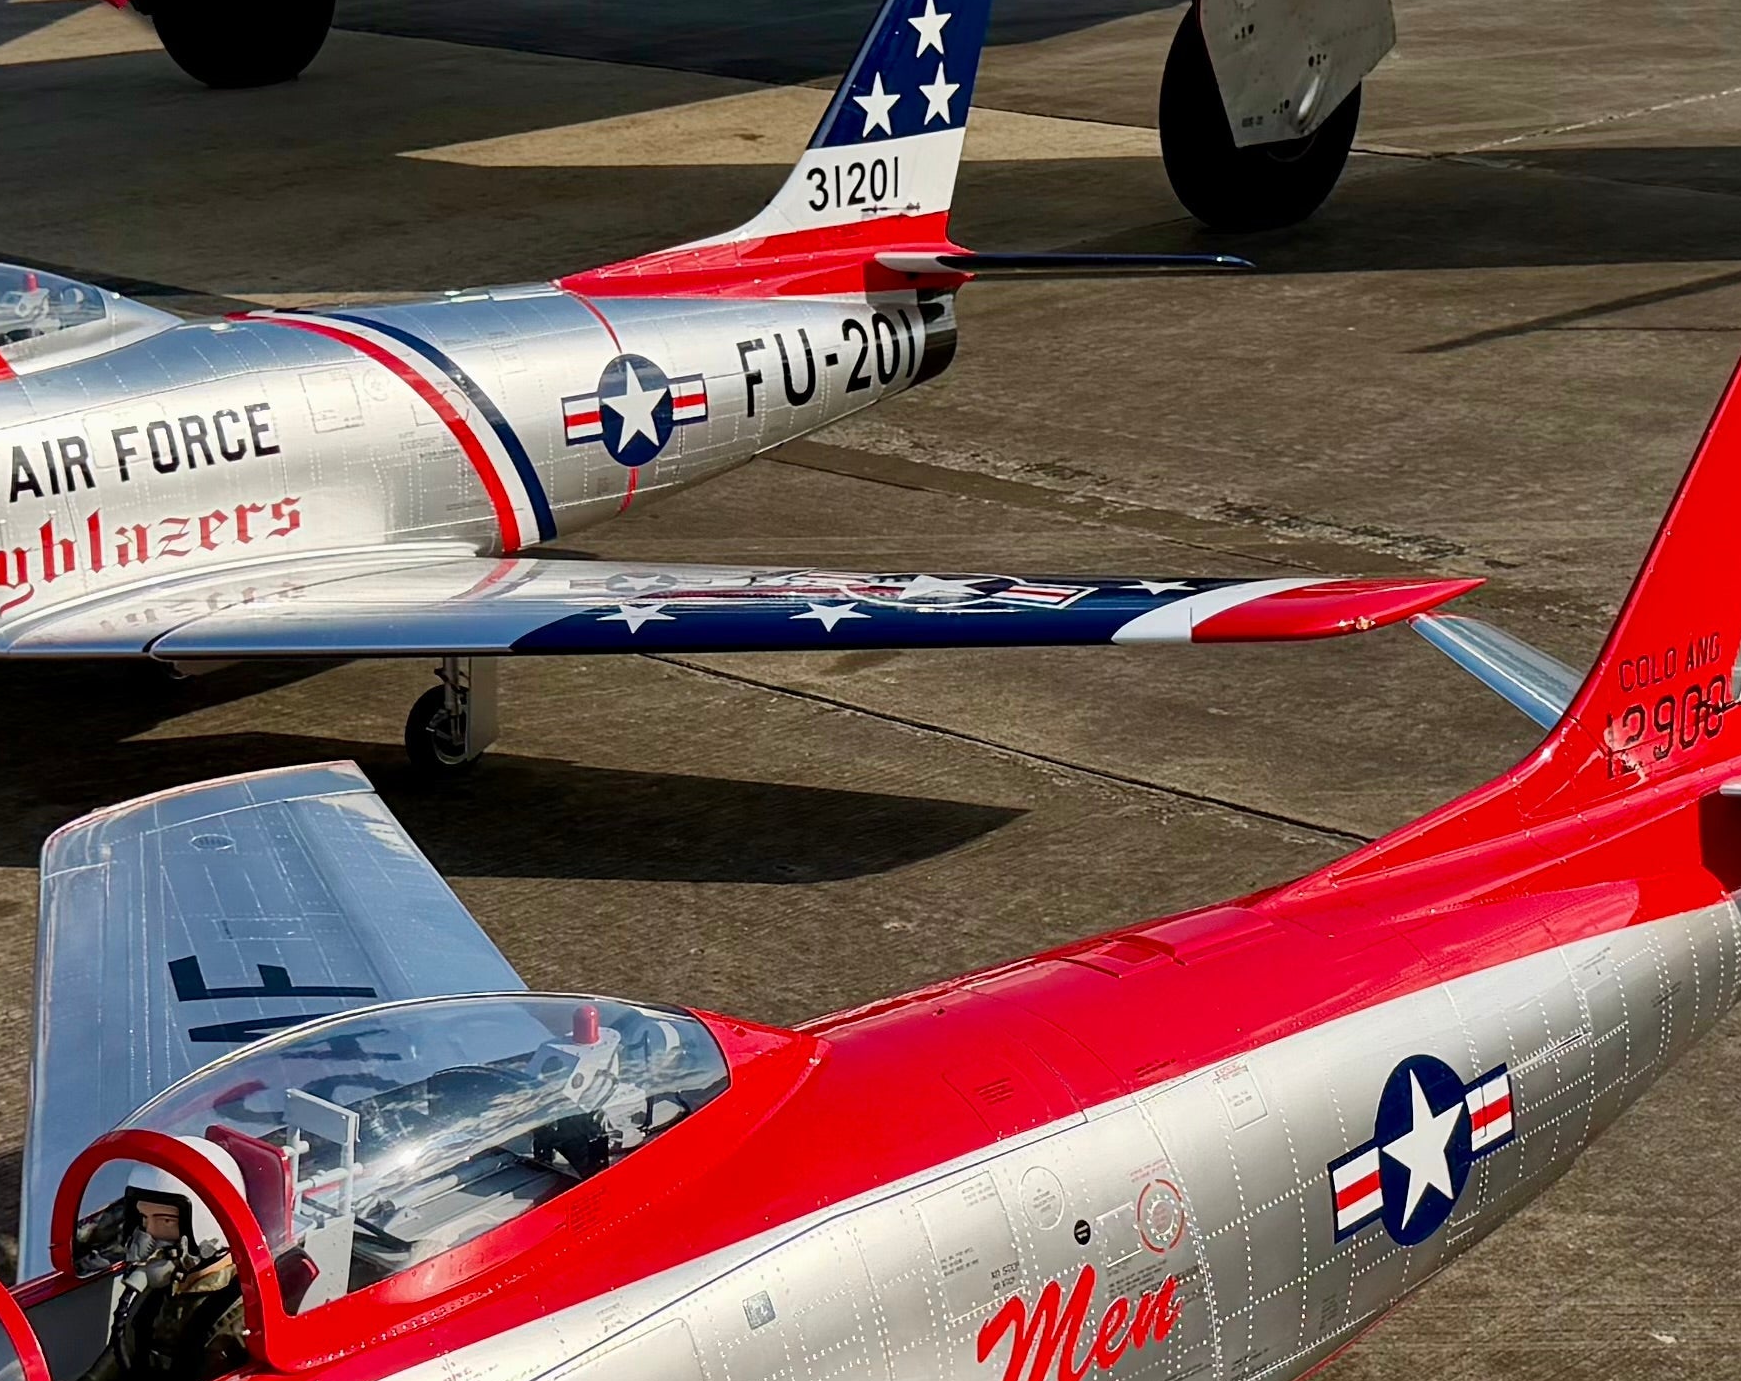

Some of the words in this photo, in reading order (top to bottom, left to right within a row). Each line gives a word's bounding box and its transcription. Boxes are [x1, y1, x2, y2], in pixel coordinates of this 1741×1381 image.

[806, 156, 899, 212] 31201
[736, 309, 916, 418] FU-201
[9, 440, 97, 503] AIR
[113, 402, 282, 481] FORCE
[1618, 646, 1677, 692] COLO
[1684, 632, 1721, 673] ANG
